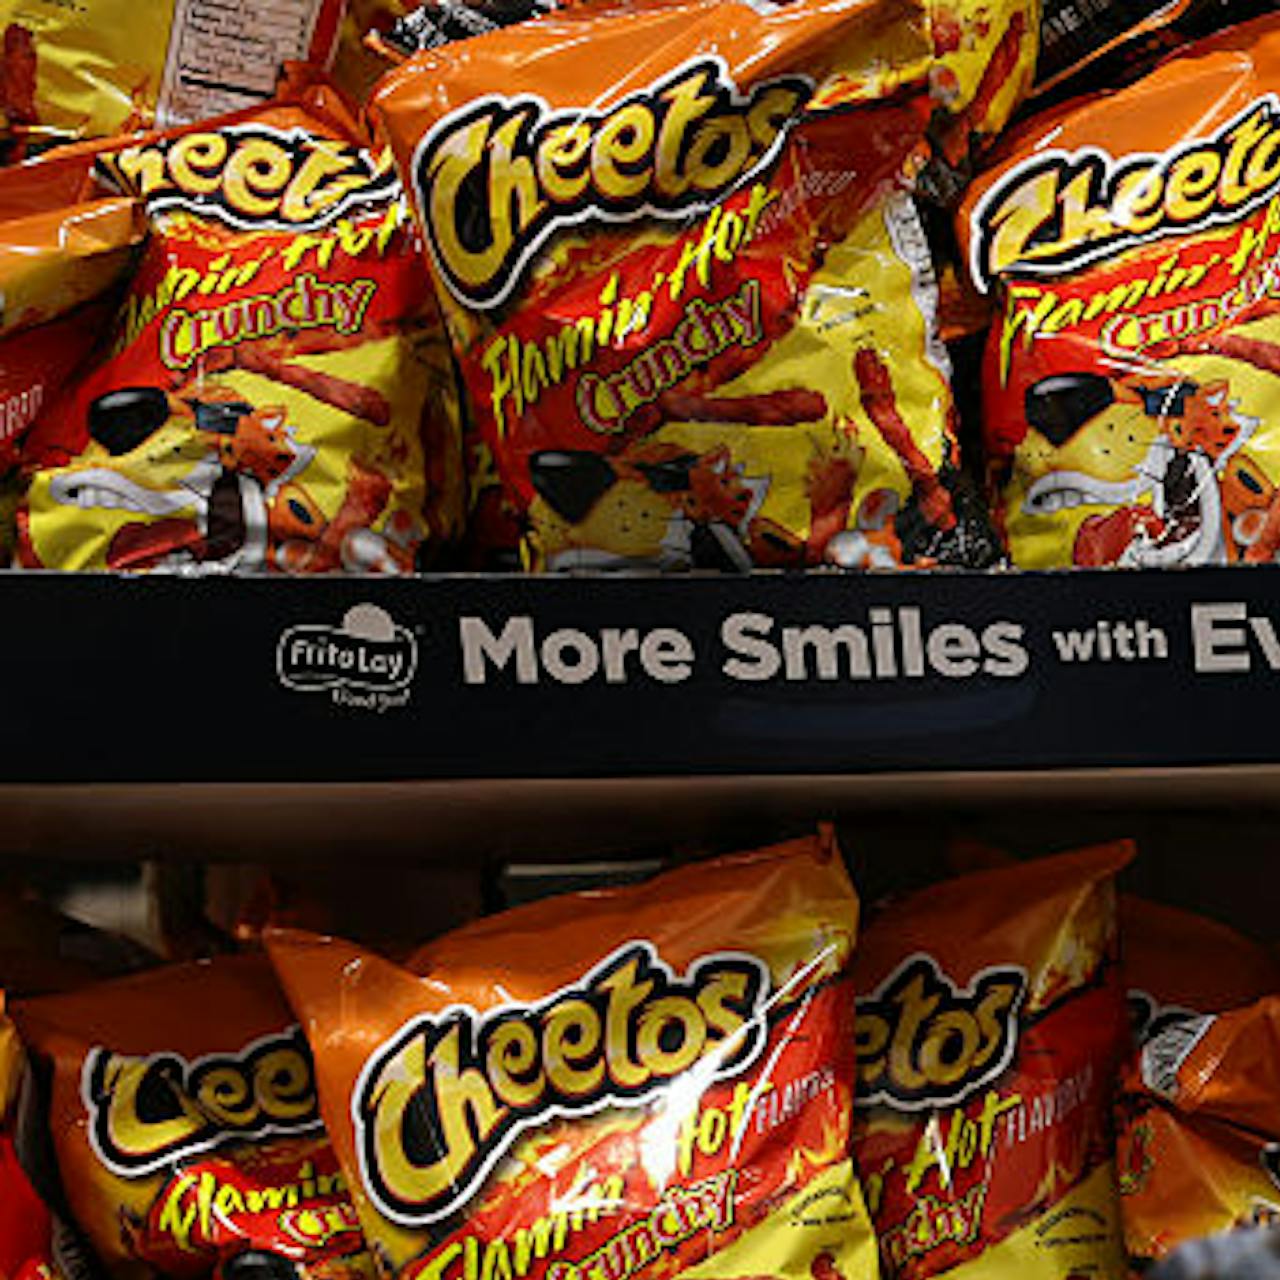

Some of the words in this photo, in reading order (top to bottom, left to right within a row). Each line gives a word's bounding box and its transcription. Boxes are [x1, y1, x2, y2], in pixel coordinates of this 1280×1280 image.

[420, 58, 803, 300] Cheetos
[160, 272, 376, 370] Crunchy
[576, 281, 764, 433] Crunchy
[459, 613, 696, 685] More
[720, 606, 1030, 682] Smiles
[1052, 621, 1168, 662] with
[362, 944, 762, 1212] Cheetos
